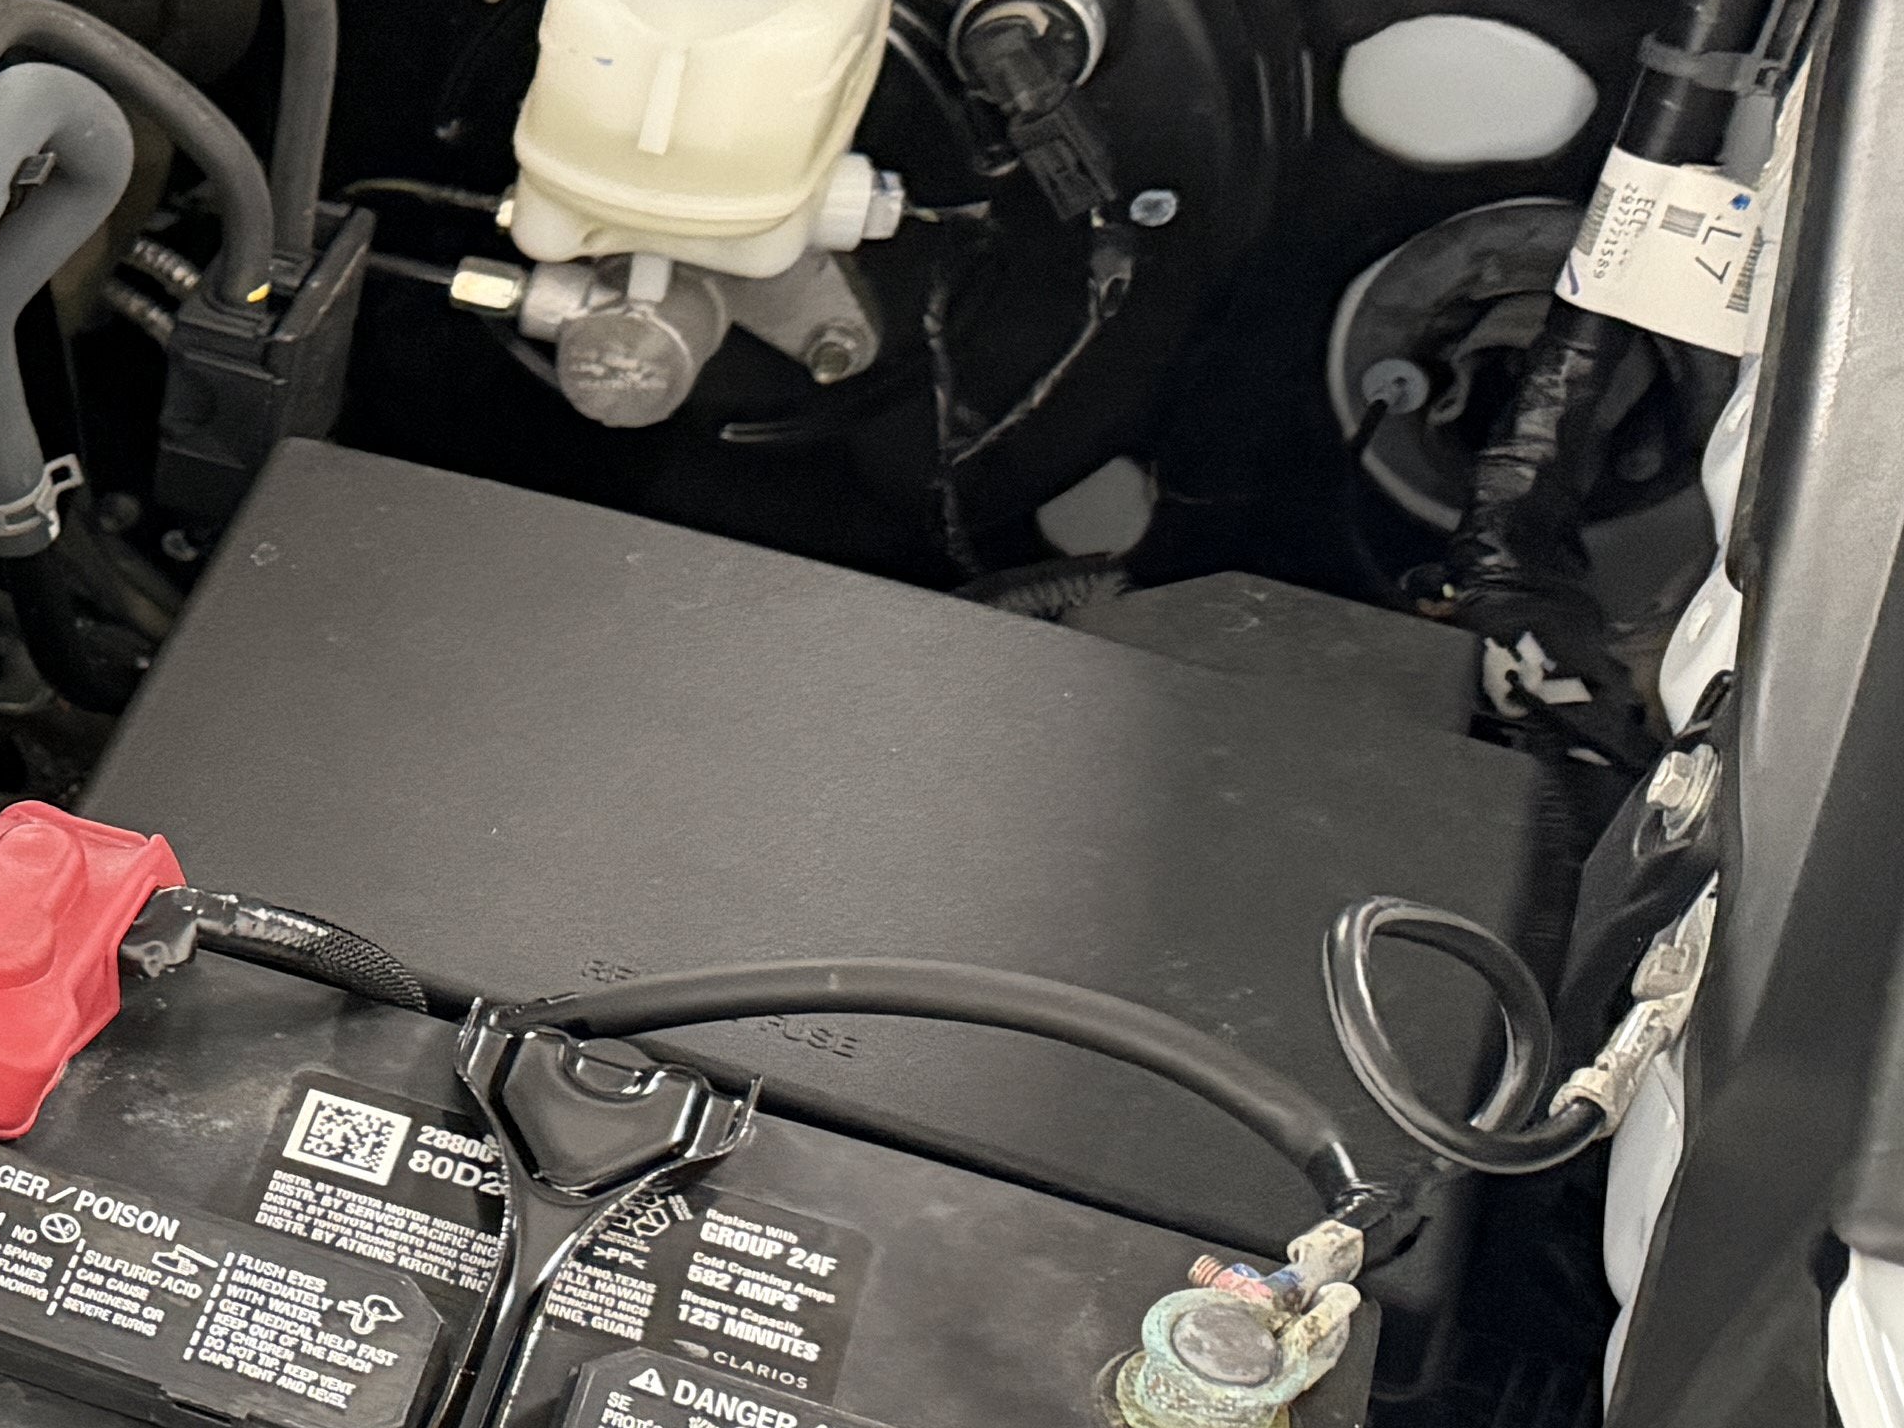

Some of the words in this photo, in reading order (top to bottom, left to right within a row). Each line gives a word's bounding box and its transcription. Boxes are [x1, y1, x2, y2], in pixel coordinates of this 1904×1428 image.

[10, 1224, 38, 1244] NO
[73, 1189, 181, 1242] POISON
[407, 1221, 469, 1249] PACIFIC
[310, 1227, 337, 1244] BY
[335, 1236, 397, 1264] ATKINS
[699, 1221, 784, 1260] GROUP
[786, 1247, 838, 1277] 24F
[82, 1249, 163, 1286] SULFURIC
[160, 1275, 204, 1300] ACID
[230, 1268, 335, 1312] IMMEDIATELY
[236, 1253, 287, 1280] FLUSH
[286, 1269, 328, 1293] EYES
[226, 1283, 266, 1307] WITH
[734, 1279, 801, 1312] AMPS
[218, 1298, 252, 1318] GET
[251, 1308, 314, 1342] MEDICAL
[315, 1330, 358, 1353] HELP
[356, 1343, 399, 1367] FAST
[590, 1315, 644, 1342] GUAM
[678, 1304, 722, 1331] 125
[722, 1317, 821, 1362] MINUTES
[713, 1351, 808, 1390] CLARIOS
[606, 1391, 634, 1412] SE
